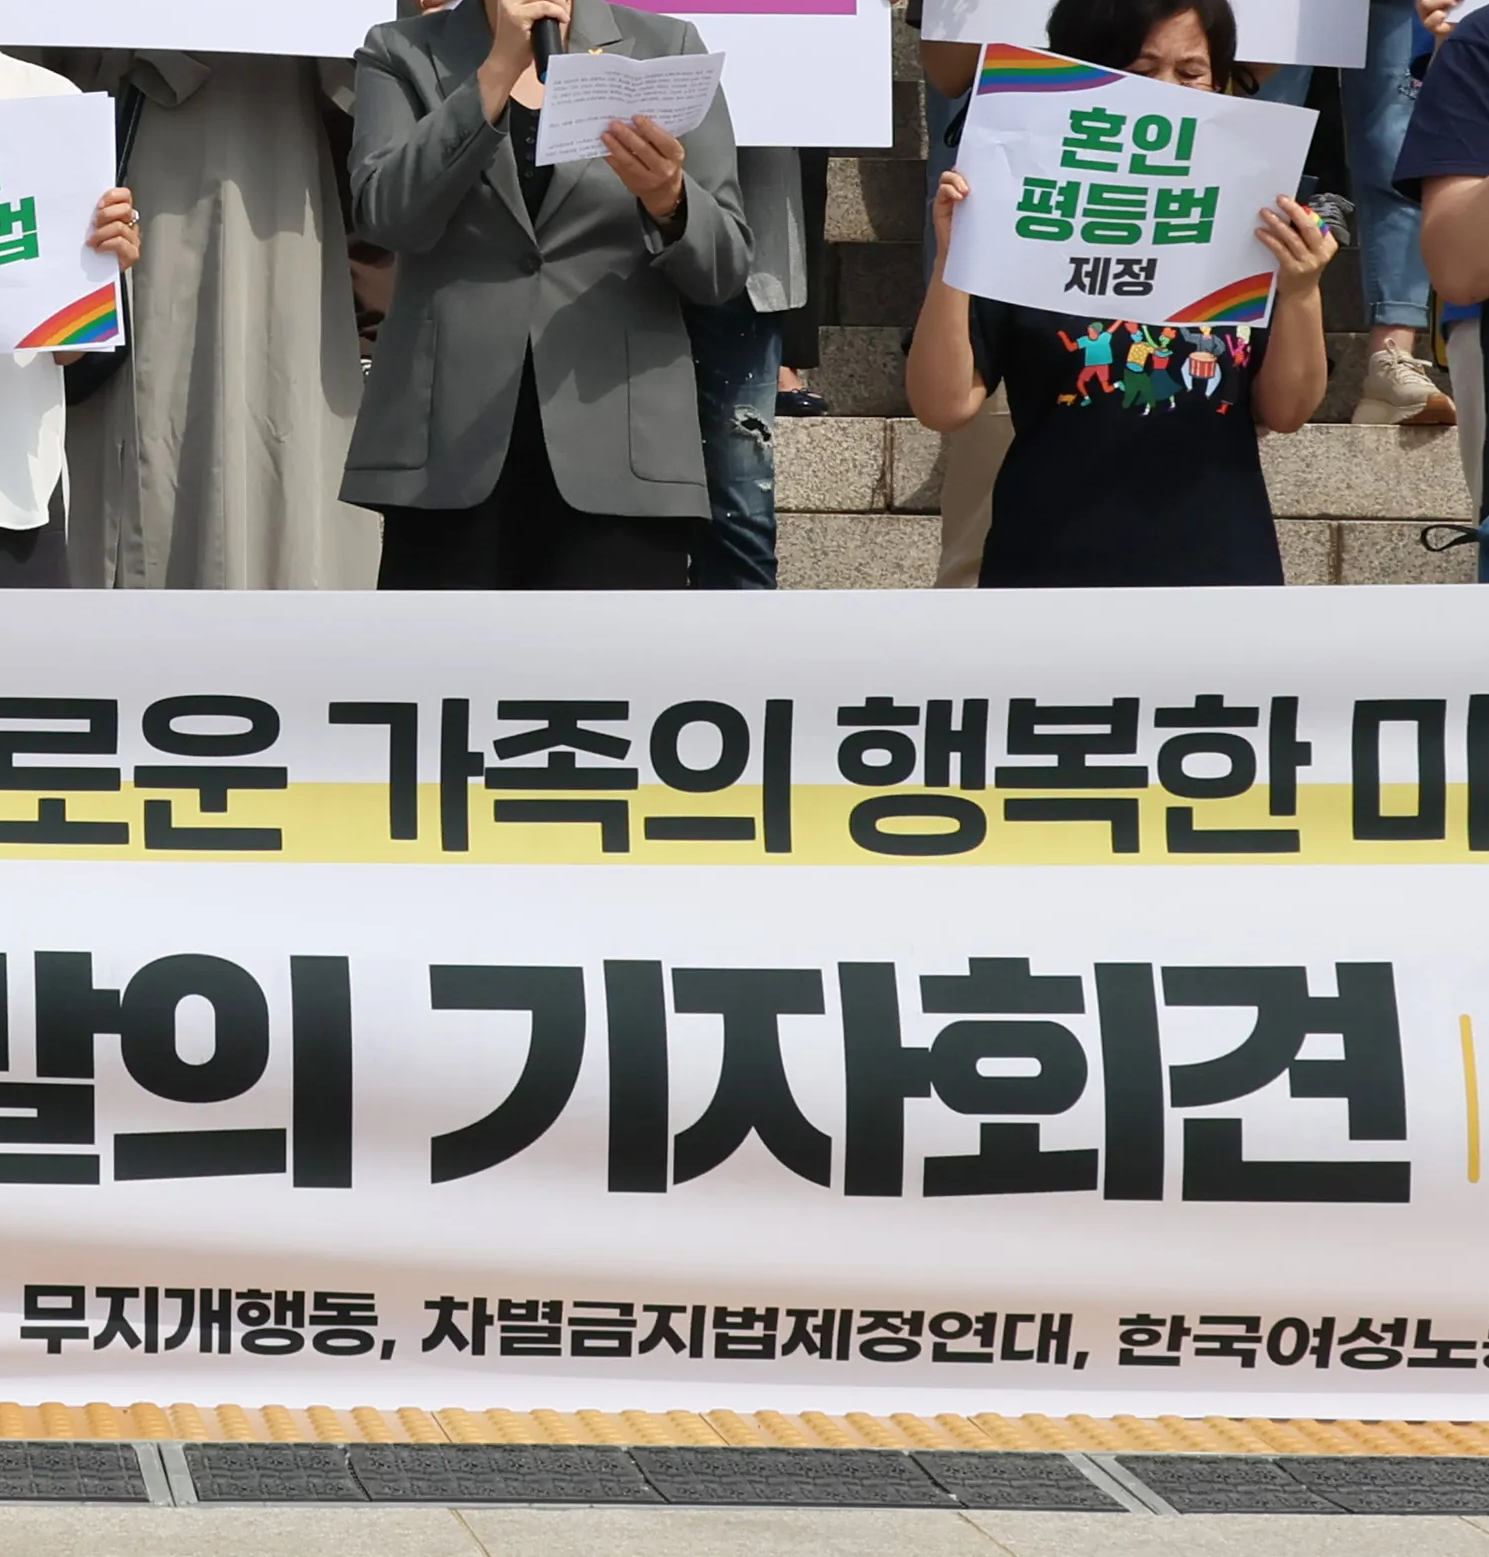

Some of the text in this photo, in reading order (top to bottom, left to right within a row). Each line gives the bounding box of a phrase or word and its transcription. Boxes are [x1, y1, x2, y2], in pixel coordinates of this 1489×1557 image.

[1060, 104, 1195, 176] 혼인
[1014, 178, 1218, 245] 평등법
[1065, 258, 1157, 295] 제정
[329, 698, 793, 852] 가족의
[837, 695, 1311, 855] 행복한
[430, 958, 1410, 1203] 기자회견
[21, 1285, 395, 1359] 무지개행동,
[422, 1296, 1088, 1369] 차별금지법제정연대,
